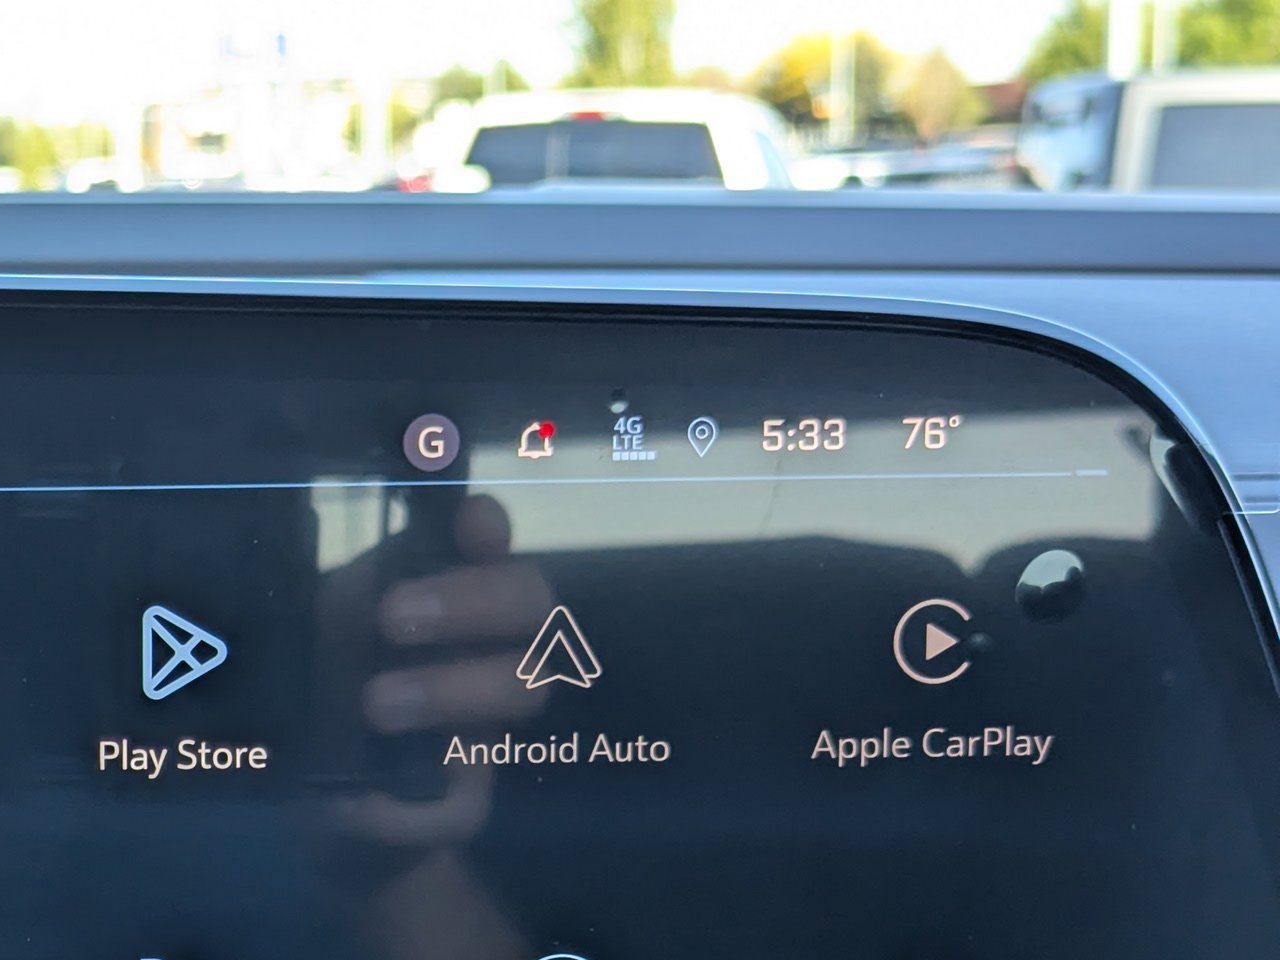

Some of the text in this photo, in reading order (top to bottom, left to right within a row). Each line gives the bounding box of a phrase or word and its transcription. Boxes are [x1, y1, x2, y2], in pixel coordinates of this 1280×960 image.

[418, 426, 445, 459] G
[612, 434, 643, 451] LTE
[613, 416, 643, 436] 4G
[762, 419, 846, 452] 5:33
[902, 415, 960, 449] 76°
[99, 738, 268, 780] Play Store
[443, 732, 670, 765] Android Auto
[810, 725, 1053, 768] Apple CarPlay
